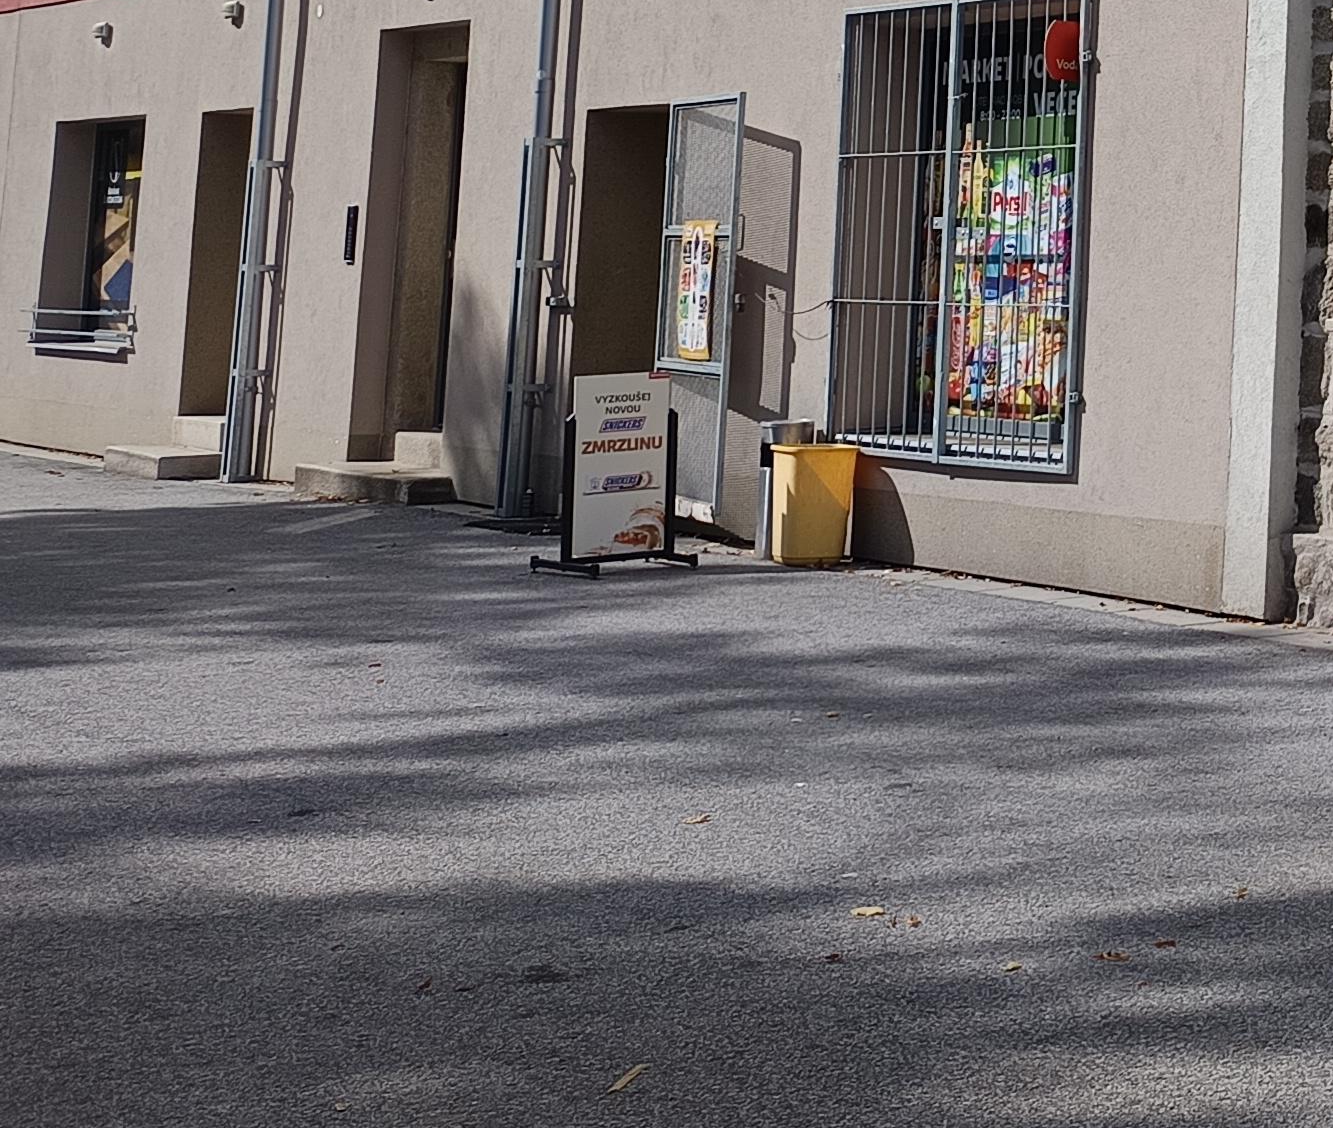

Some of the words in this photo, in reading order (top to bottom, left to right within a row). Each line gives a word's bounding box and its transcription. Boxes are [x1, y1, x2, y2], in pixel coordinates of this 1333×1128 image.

[1056, 58, 1078, 71] Vod
[1033, 84, 1077, 119] VEČE
[594, 390, 651, 404] VYZKOUŠEJ
[605, 405, 642, 415] NOVOU
[602, 417, 644, 431] SNICKERS
[581, 435, 664, 455] ZMRZLINU
